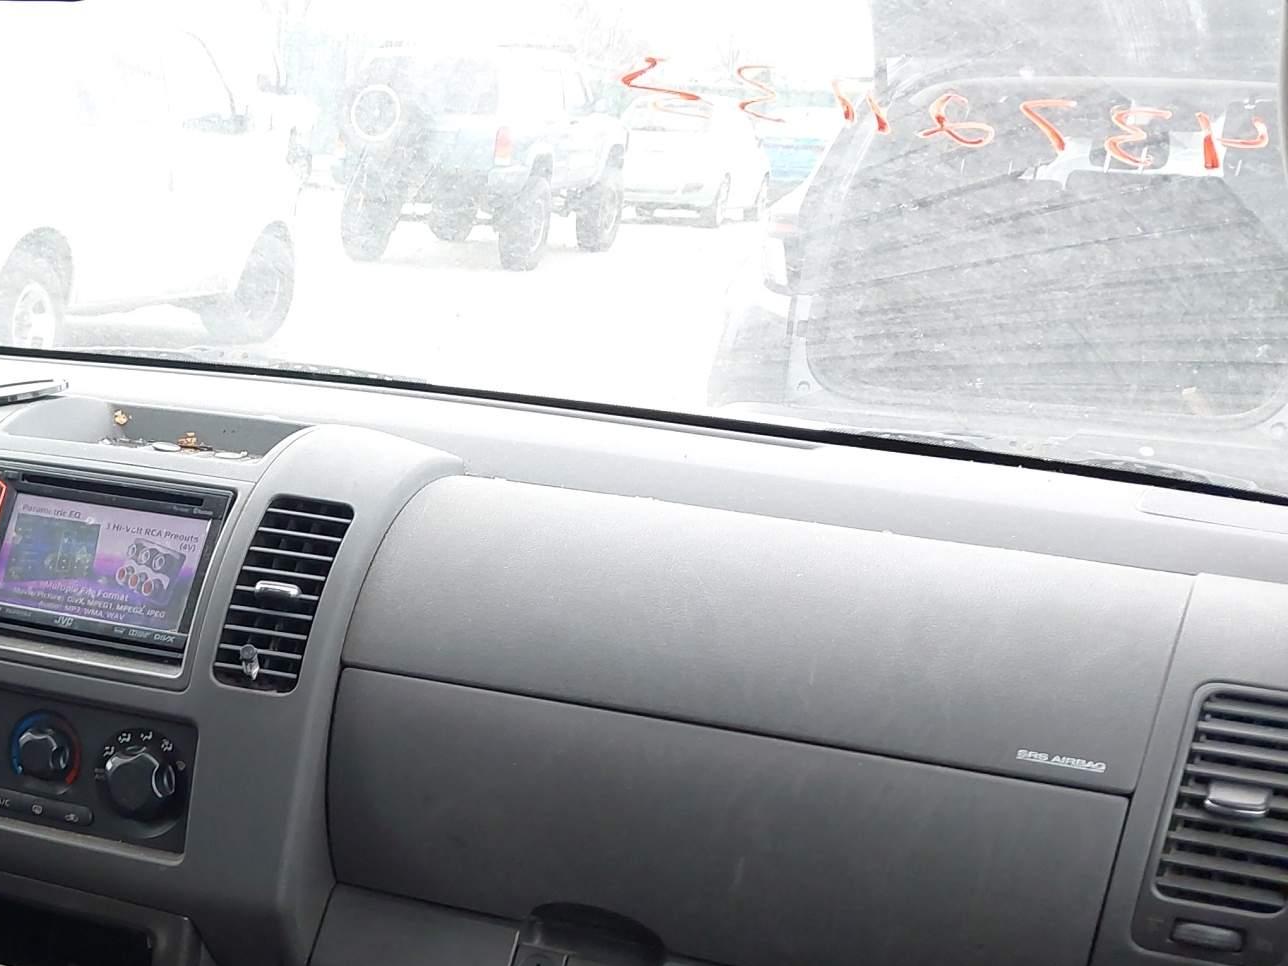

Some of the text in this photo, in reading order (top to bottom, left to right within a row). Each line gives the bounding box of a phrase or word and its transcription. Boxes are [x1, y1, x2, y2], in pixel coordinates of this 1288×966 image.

[144, 528, 163, 537] RCA
[54, 616, 73, 626] JVC
[1016, 749, 1107, 770] SRS AIRBAG
